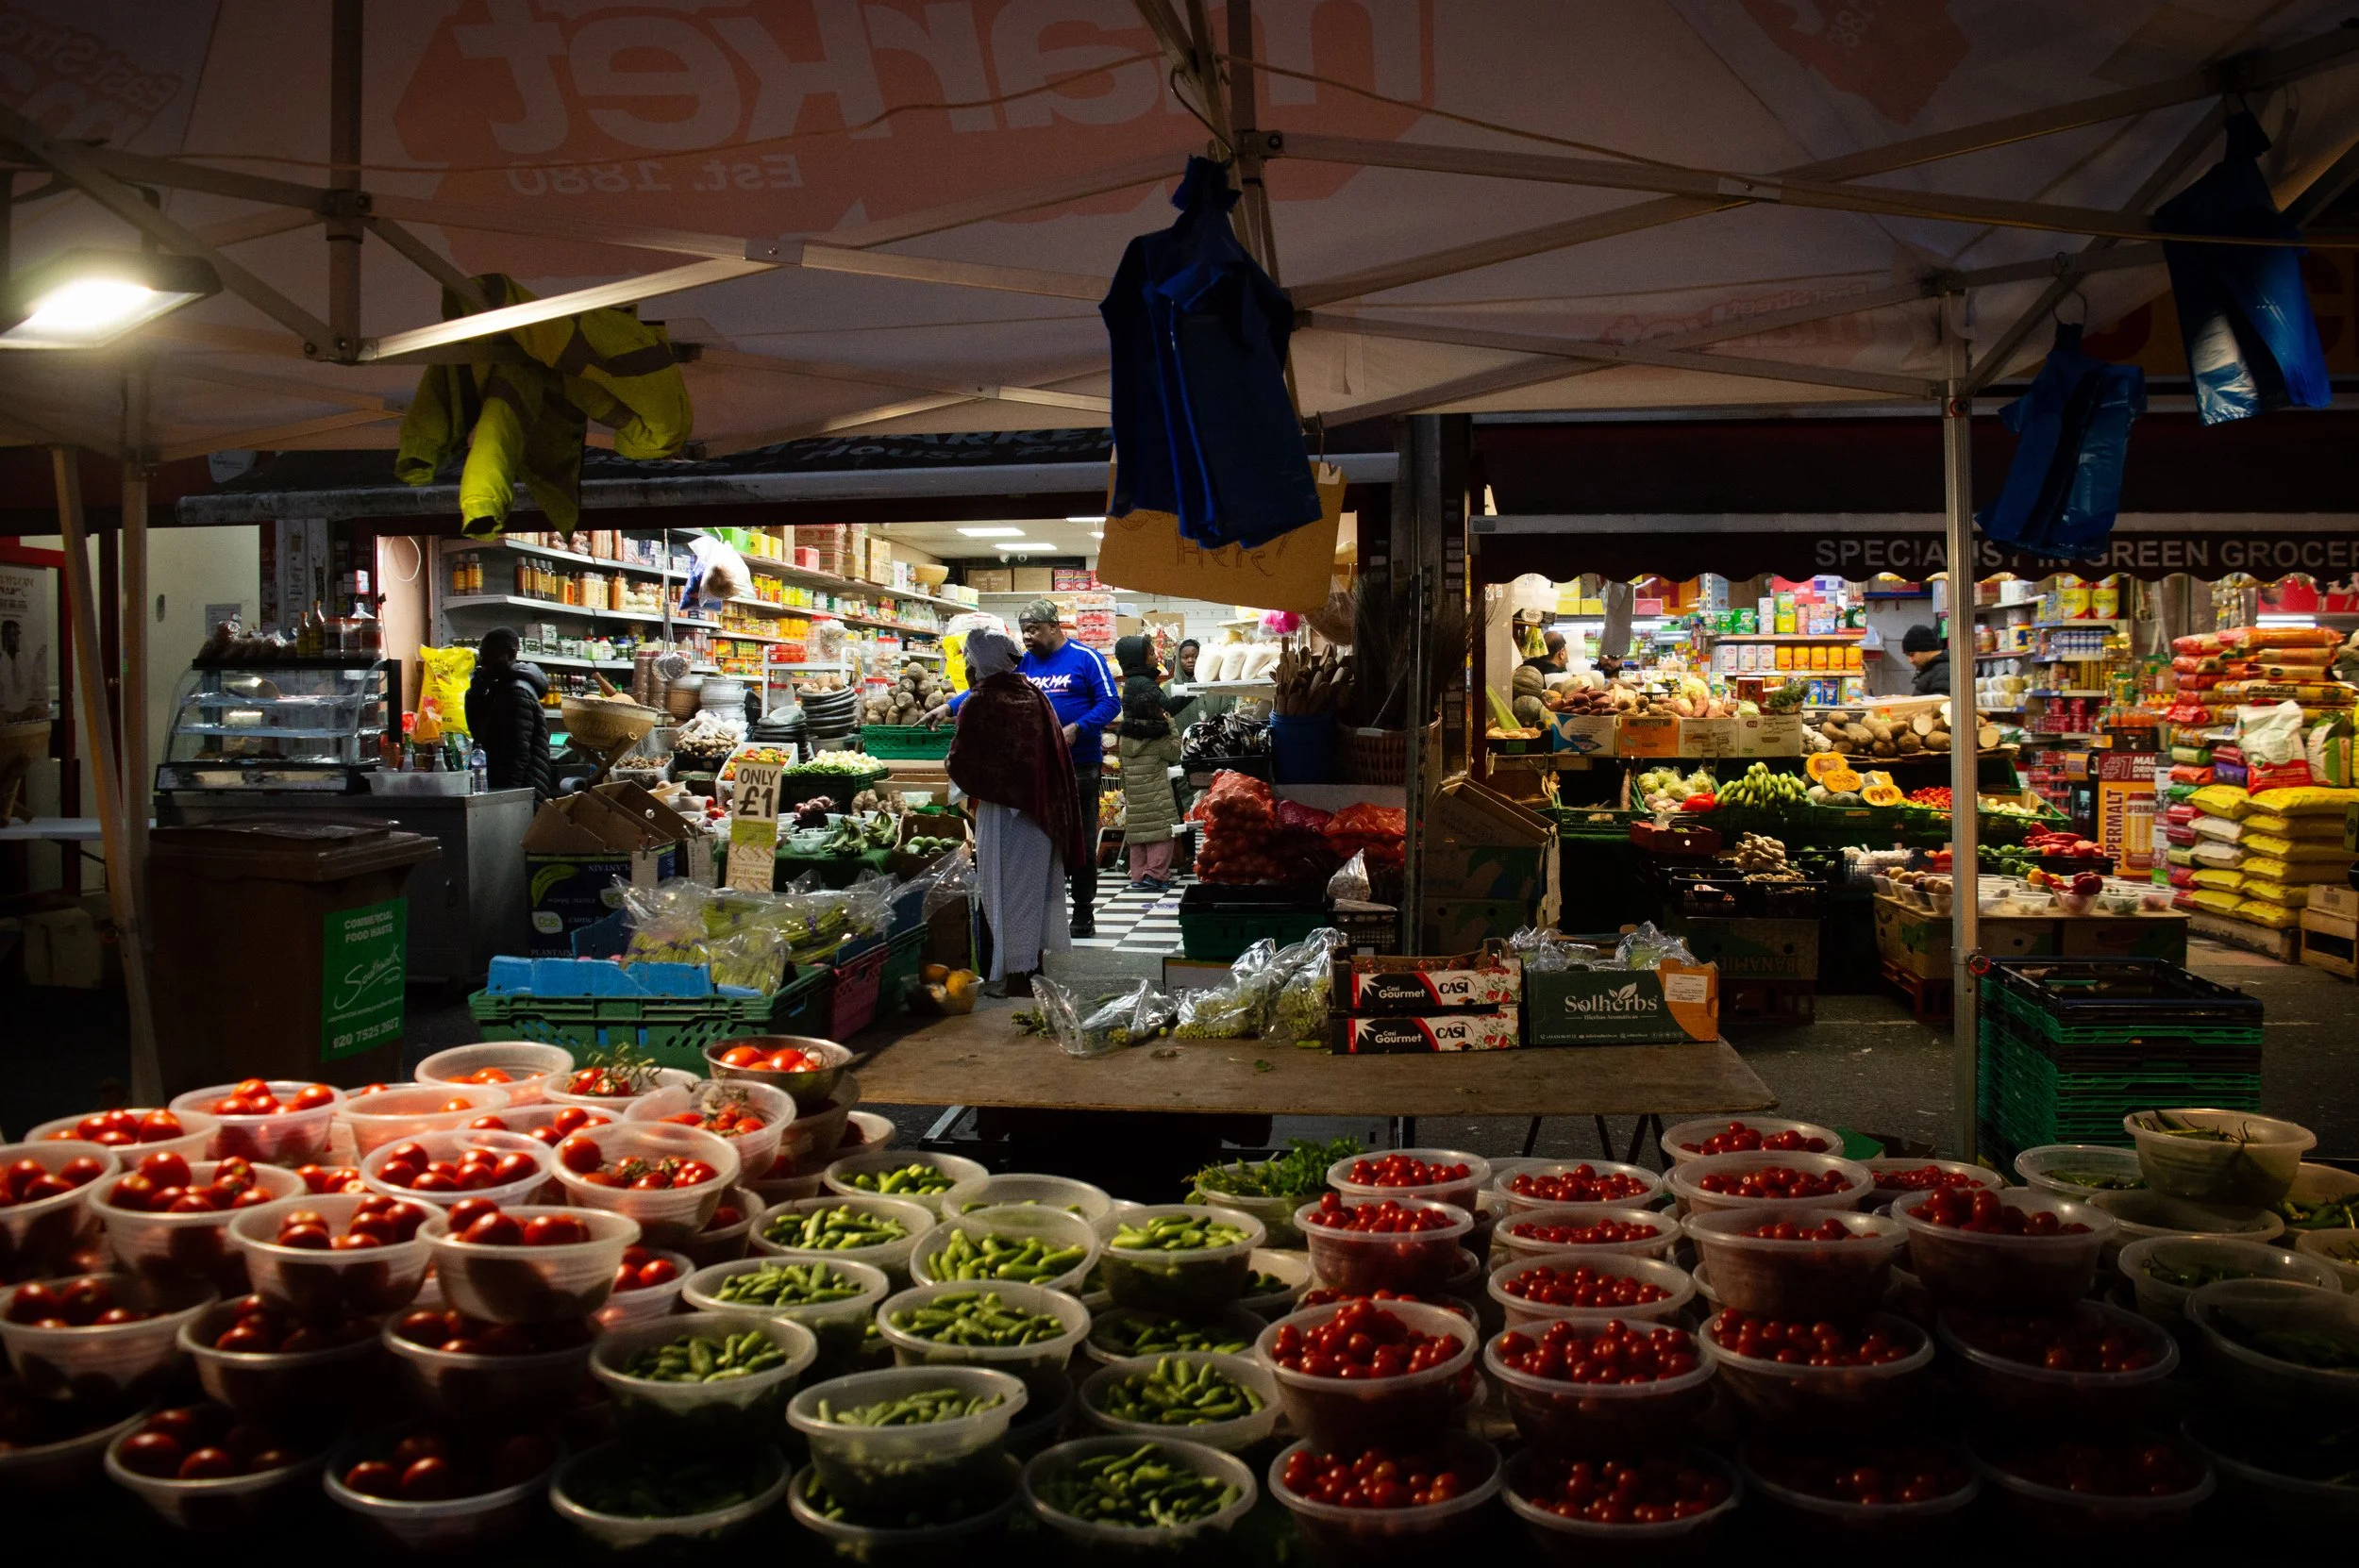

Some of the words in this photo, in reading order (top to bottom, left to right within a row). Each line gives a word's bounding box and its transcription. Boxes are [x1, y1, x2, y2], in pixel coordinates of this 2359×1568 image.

[740, 768, 778, 786] ONLY
[2101, 756, 2133, 779] #1
[738, 786, 775, 818] £1
[343, 909, 393, 930] COMMERCIAL
[344, 928, 369, 944] FOOD
[369, 923, 394, 938] WASTE
[1712, 955, 1797, 974] BANAMIE
[1378, 989, 1427, 1000] Gourmet
[1438, 981, 1469, 994] CASI
[332, 1032, 354, 1049] 020
[356, 1024, 379, 1043] 7525
[1374, 1033, 1423, 1044] Gourmet
[1435, 1026, 1466, 1040] CASI
